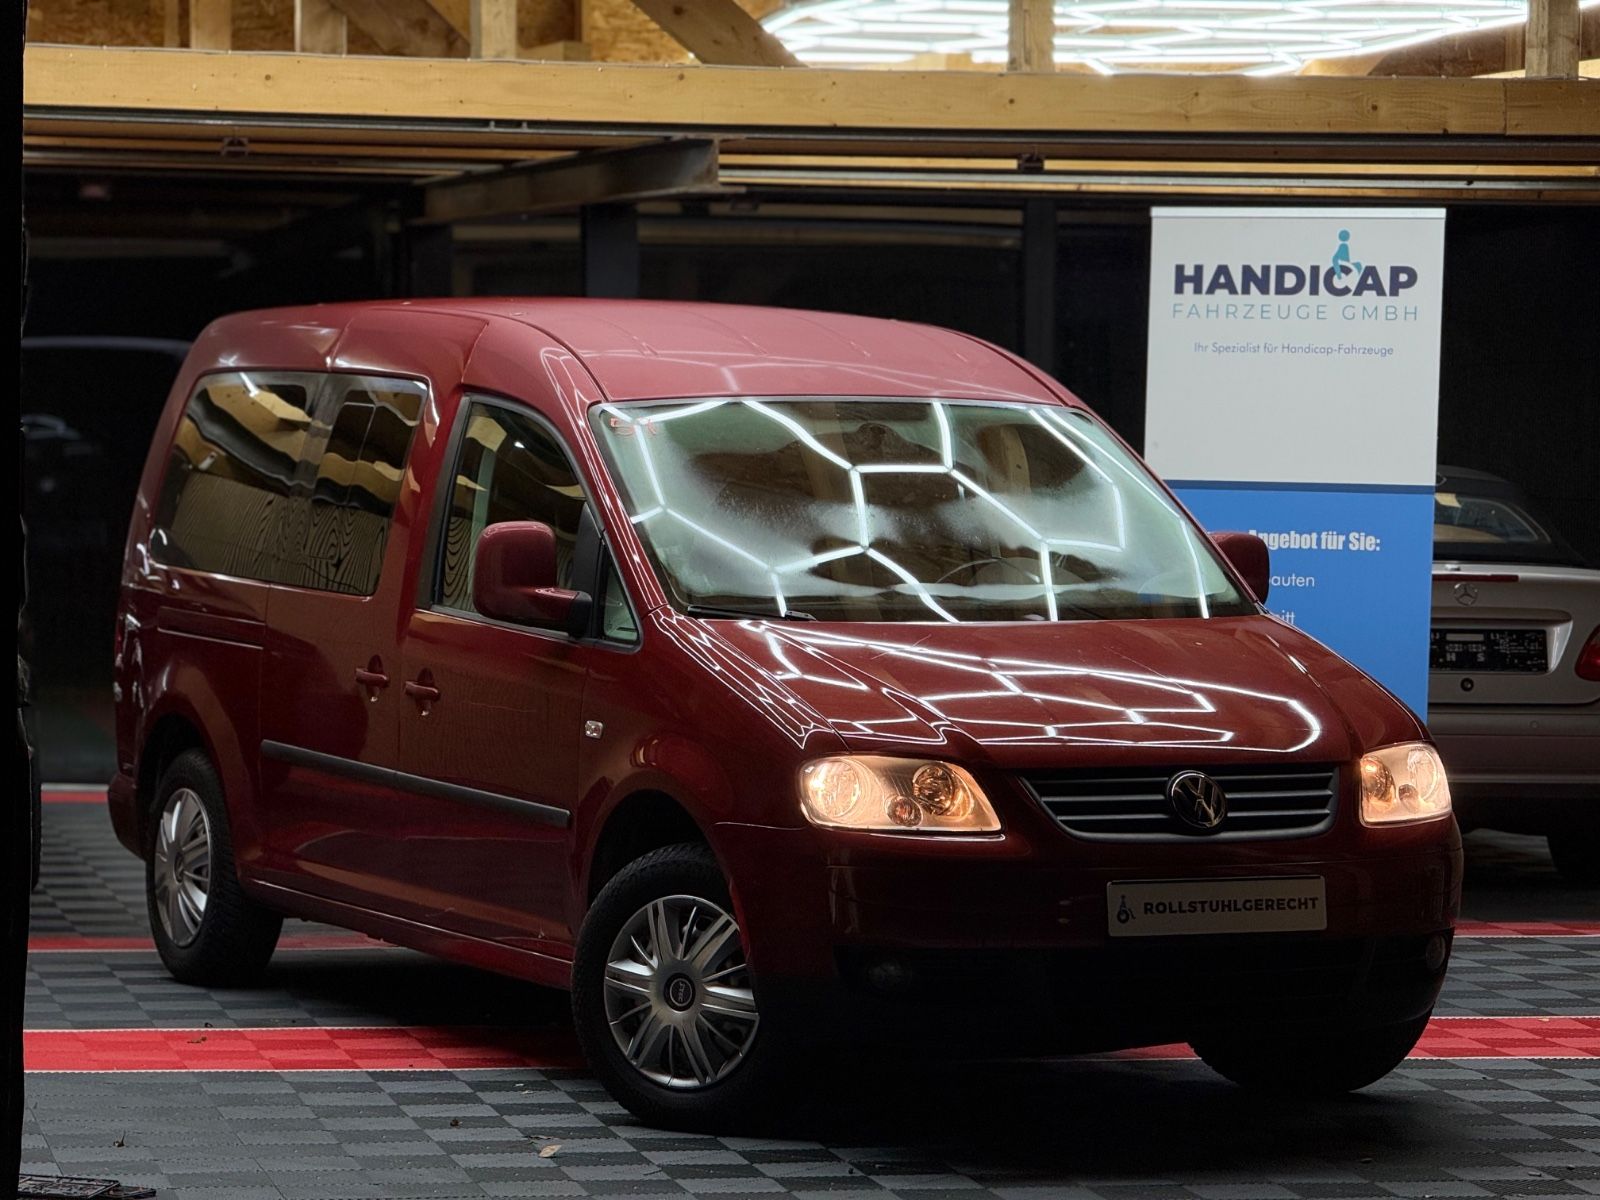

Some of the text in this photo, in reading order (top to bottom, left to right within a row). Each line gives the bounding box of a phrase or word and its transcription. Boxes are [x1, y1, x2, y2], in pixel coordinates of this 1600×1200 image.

[1174, 264, 1418, 297] HANDICAP
[1172, 303, 1418, 321] FAHRZEUGE GMBH
[1194, 342, 1394, 358] Ihr Spezialist für Handicap-Fahrzeuge
[1321, 531, 1346, 550] für
[1349, 532, 1380, 551] Sie:
[1269, 573, 1315, 587] auten
[1143, 897, 1319, 915] ROLLSTUHLGERECHT
